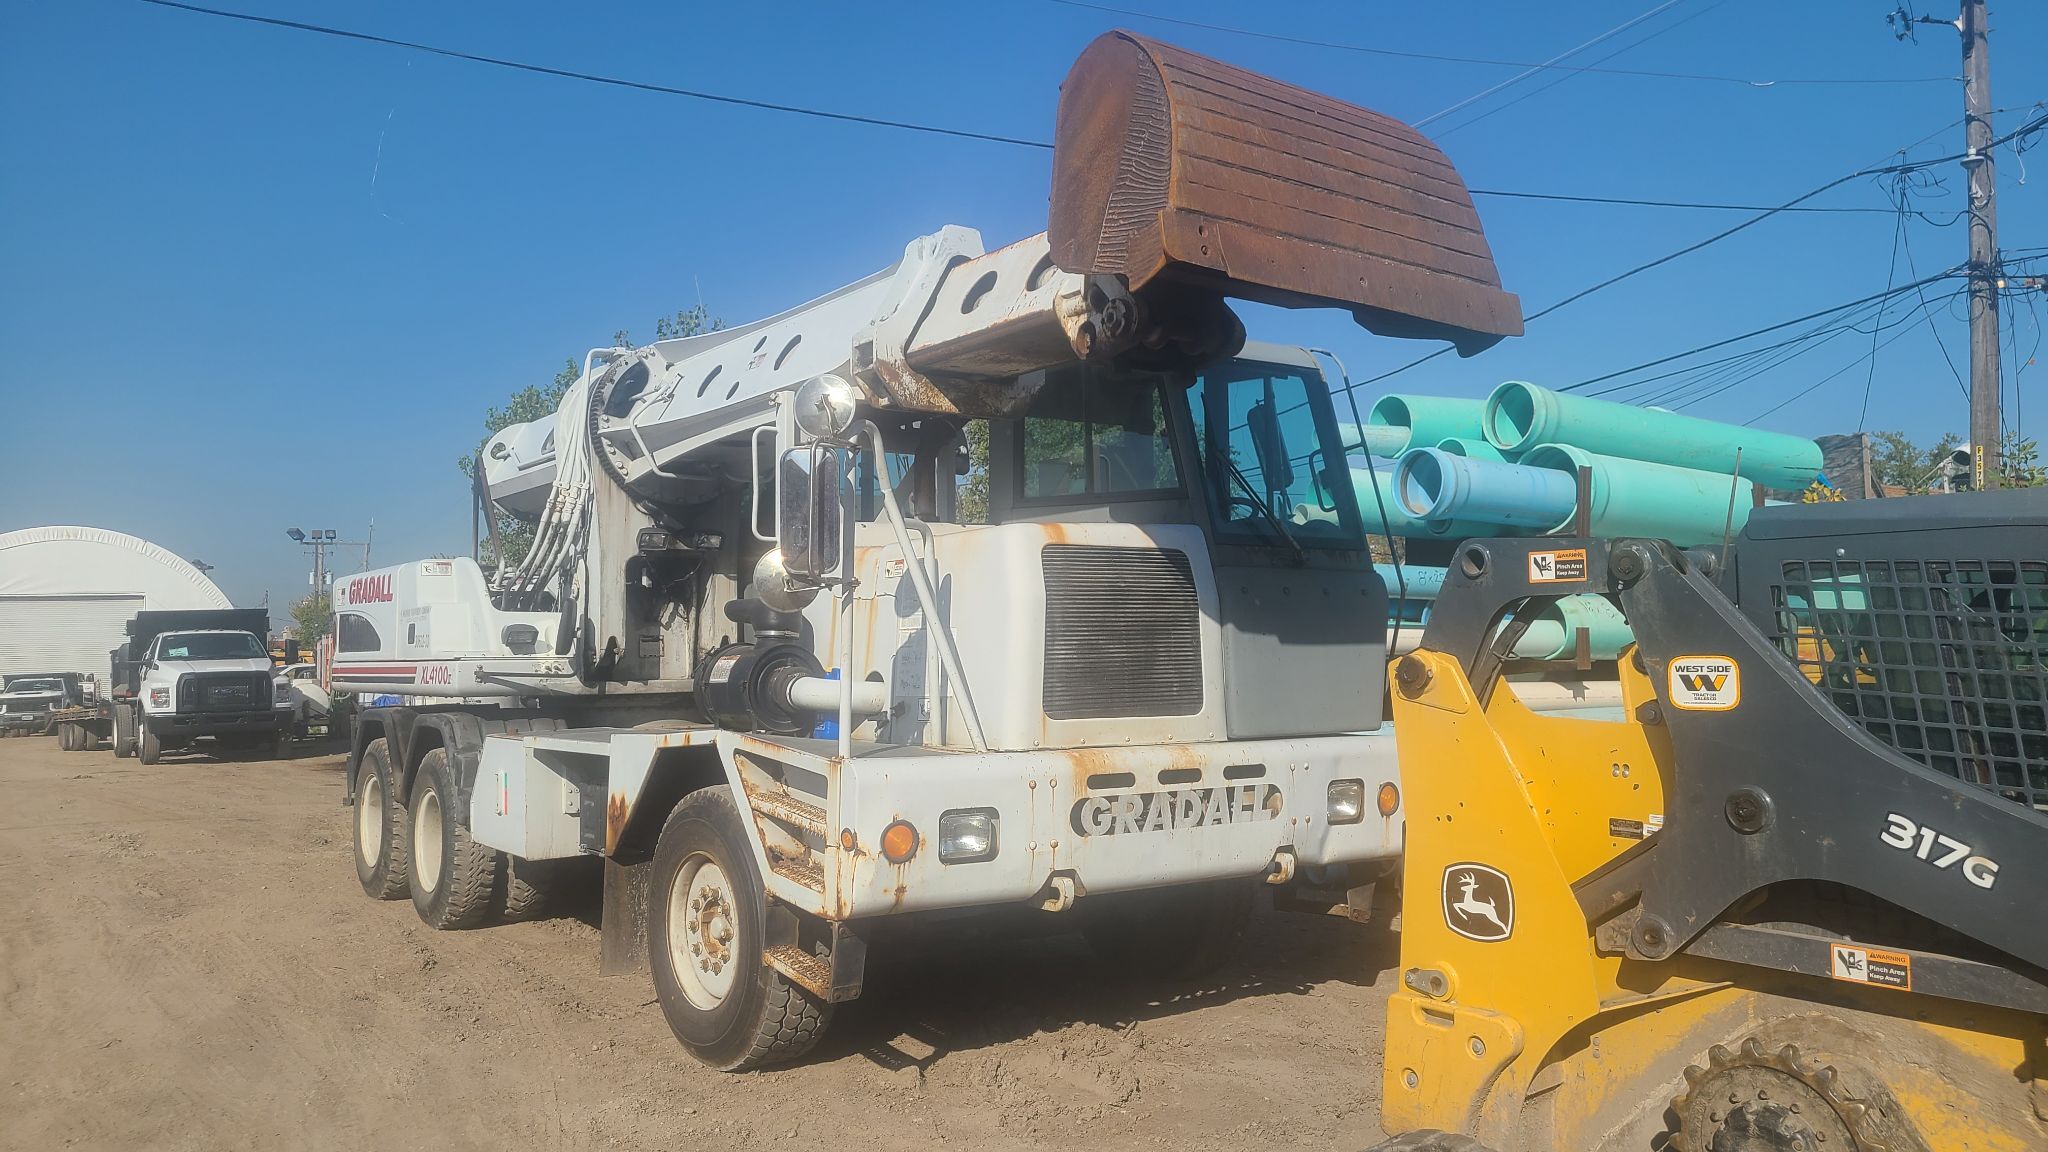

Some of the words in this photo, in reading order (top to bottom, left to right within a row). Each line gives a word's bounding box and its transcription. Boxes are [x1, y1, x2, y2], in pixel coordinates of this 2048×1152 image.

[349, 574, 393, 605] GRADALL
[1675, 665, 1705, 673] WEST
[1706, 665, 1732, 673] SIDE
[1081, 784, 1273, 837] GRADALL
[1880, 813, 2000, 889] 317G
[1875, 952, 1906, 963] WARNING
[1869, 964, 1888, 973] Pinch
[1889, 967, 1906, 976] Area
[1869, 972, 1885, 981] Keep
[1885, 974, 1901, 983] Away
